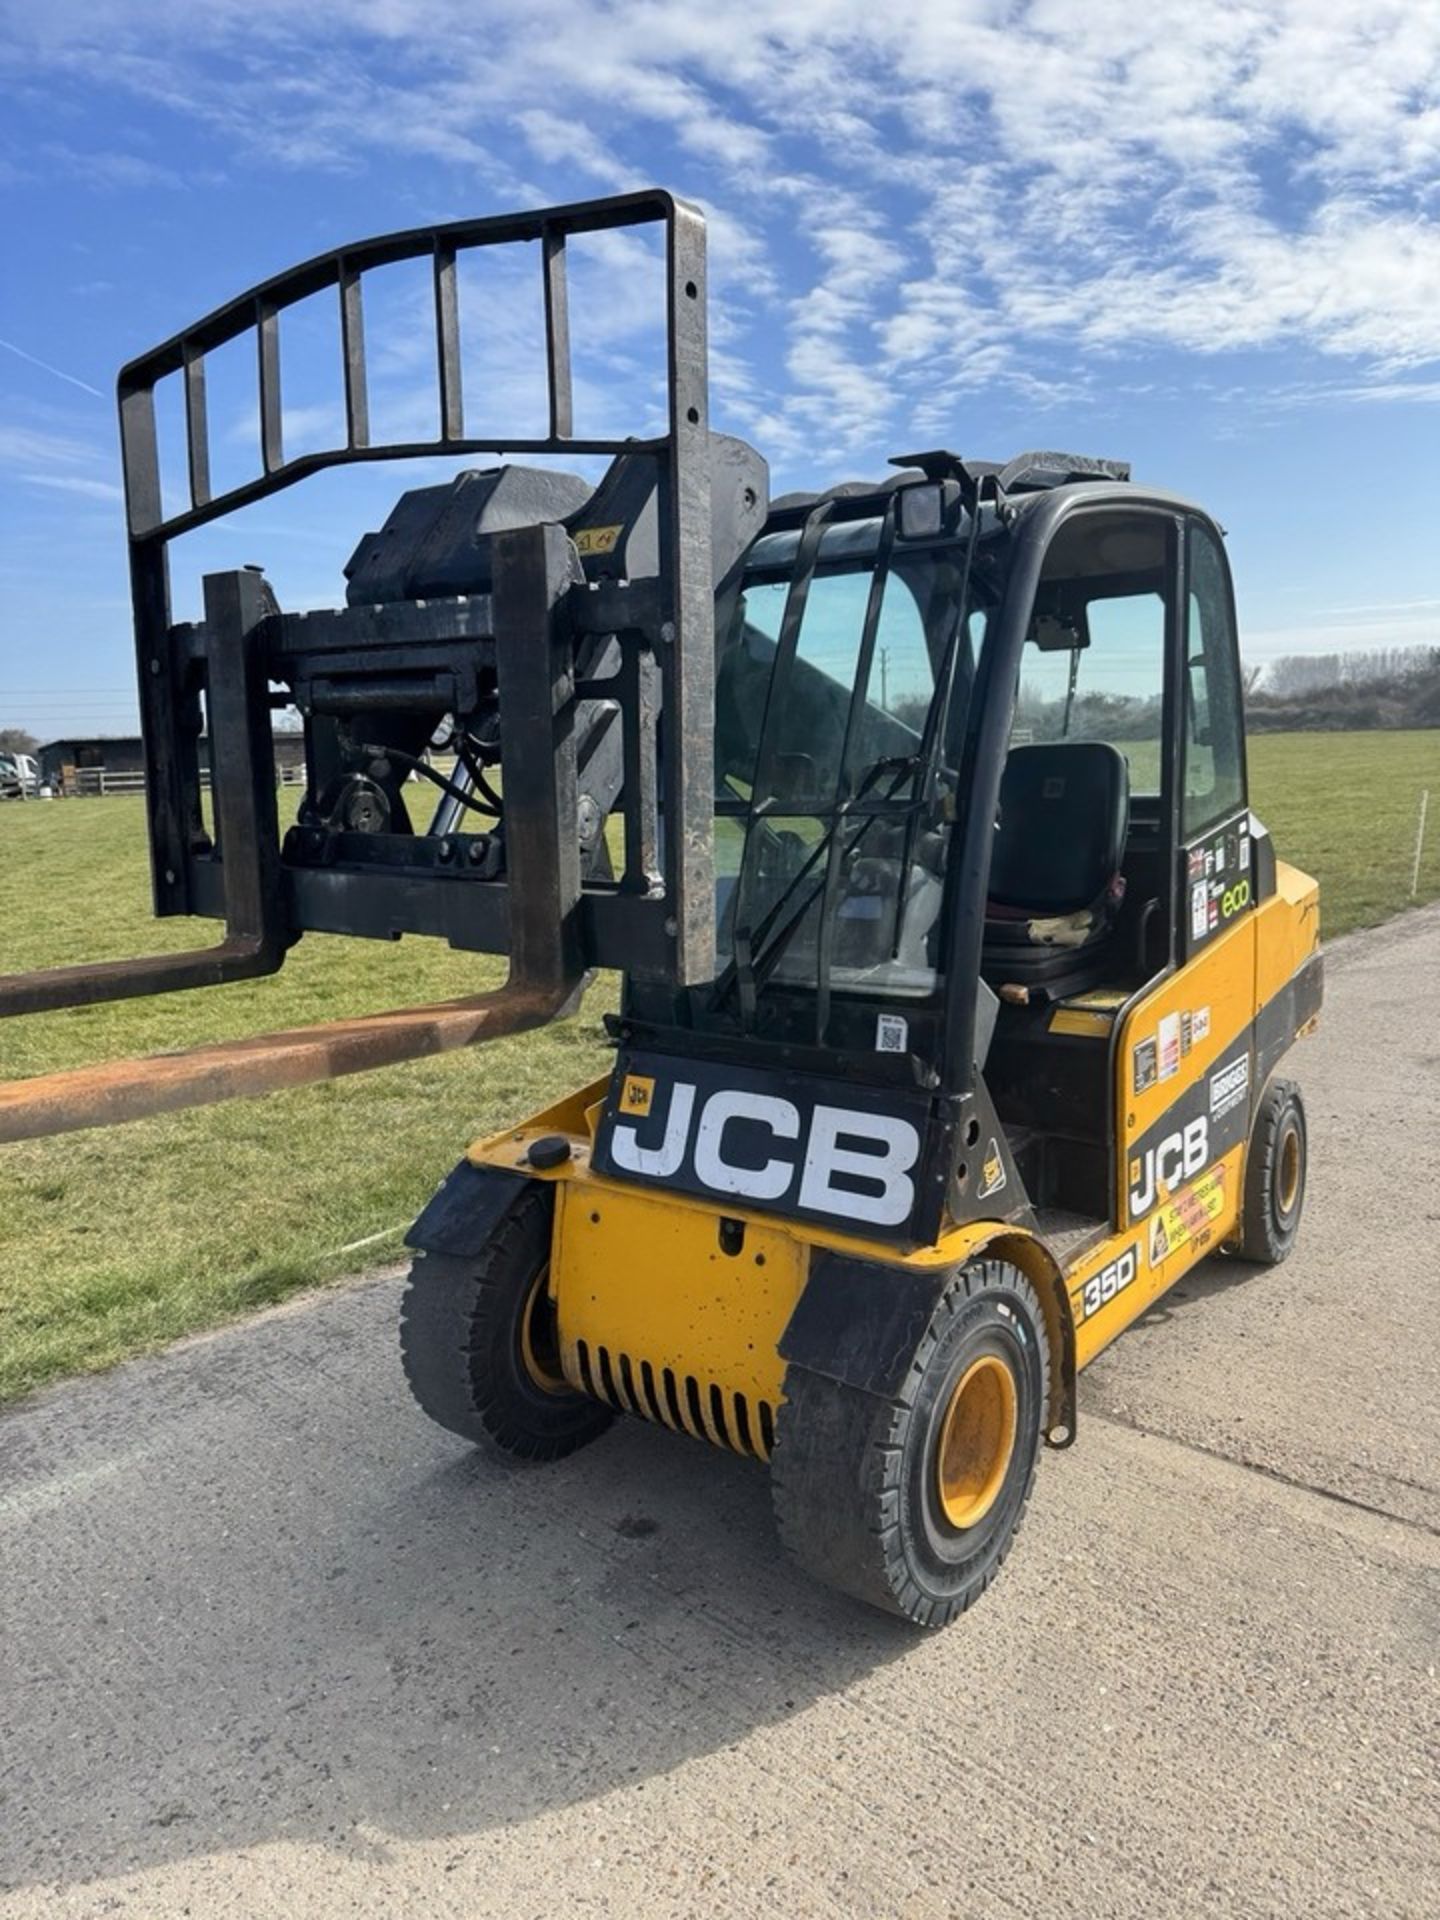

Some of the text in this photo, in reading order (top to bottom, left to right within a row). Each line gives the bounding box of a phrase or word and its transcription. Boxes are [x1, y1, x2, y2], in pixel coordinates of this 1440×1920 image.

[1222, 879, 1249, 918] eco
[611, 1082, 919, 1226] JCB
[1130, 1115, 1208, 1215] JCB
[1084, 1251, 1134, 1317] 35D
